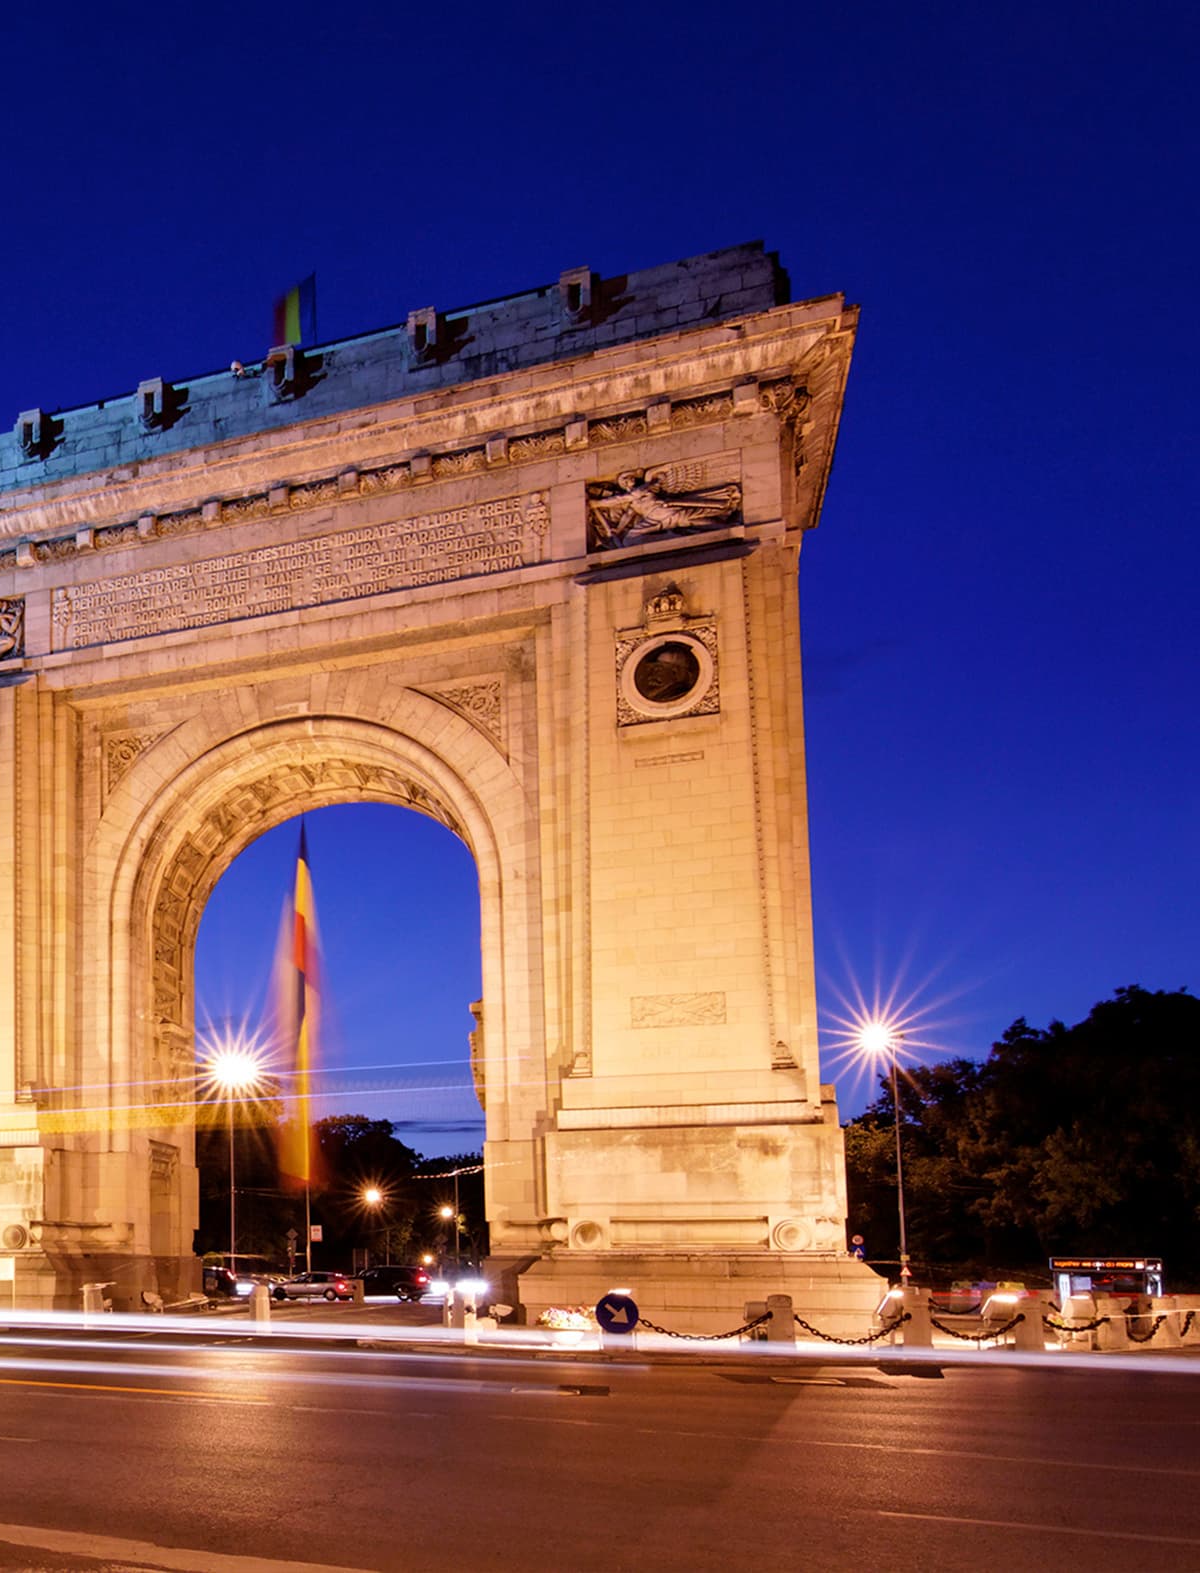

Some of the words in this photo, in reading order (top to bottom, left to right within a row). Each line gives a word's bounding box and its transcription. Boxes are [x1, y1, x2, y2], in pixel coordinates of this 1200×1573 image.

[73, 581, 102, 598] DUPA
[107, 571, 150, 591] SECOLE
[156, 567, 172, 582] DE
[335, 523, 394, 546] INDURATE
[403, 518, 418, 533] SI
[427, 508, 467, 528] LUPTE
[478, 498, 519, 518] GRELE
[73, 591, 116, 611] PENTRU
[128, 575, 196, 600] PASTRAREA
[263, 549, 330, 574] NATIONALE
[347, 539, 380, 558] DUPA
[393, 522, 465, 549] APARAREA
[73, 609, 87, 624] DE
[99, 597, 154, 619] SACRIFICII
[164, 593, 173, 606] A
[182, 578, 250, 603] CIVILIZATIEI
[314, 562, 331, 578] SE
[343, 548, 405, 572] INDEPLINI
[418, 530, 495, 558] DREPTATEA
[508, 525, 522, 541] SI
[73, 617, 116, 636] PENTRU
[133, 604, 186, 625] POPORUL
[204, 592, 245, 612] ROMAN
[262, 583, 291, 601] PRIN
[311, 572, 350, 592] SABIA
[367, 558, 423, 581] REGELUI
[446, 540, 521, 566] FERDINAND
[73, 635, 88, 649] CU
[104, 621, 160, 643] AJUTORUL
[309, 591, 320, 605] SI
[339, 578, 390, 600] GANDUL
[410, 565, 459, 587] REGINEI
[479, 553, 522, 574] MARIA
